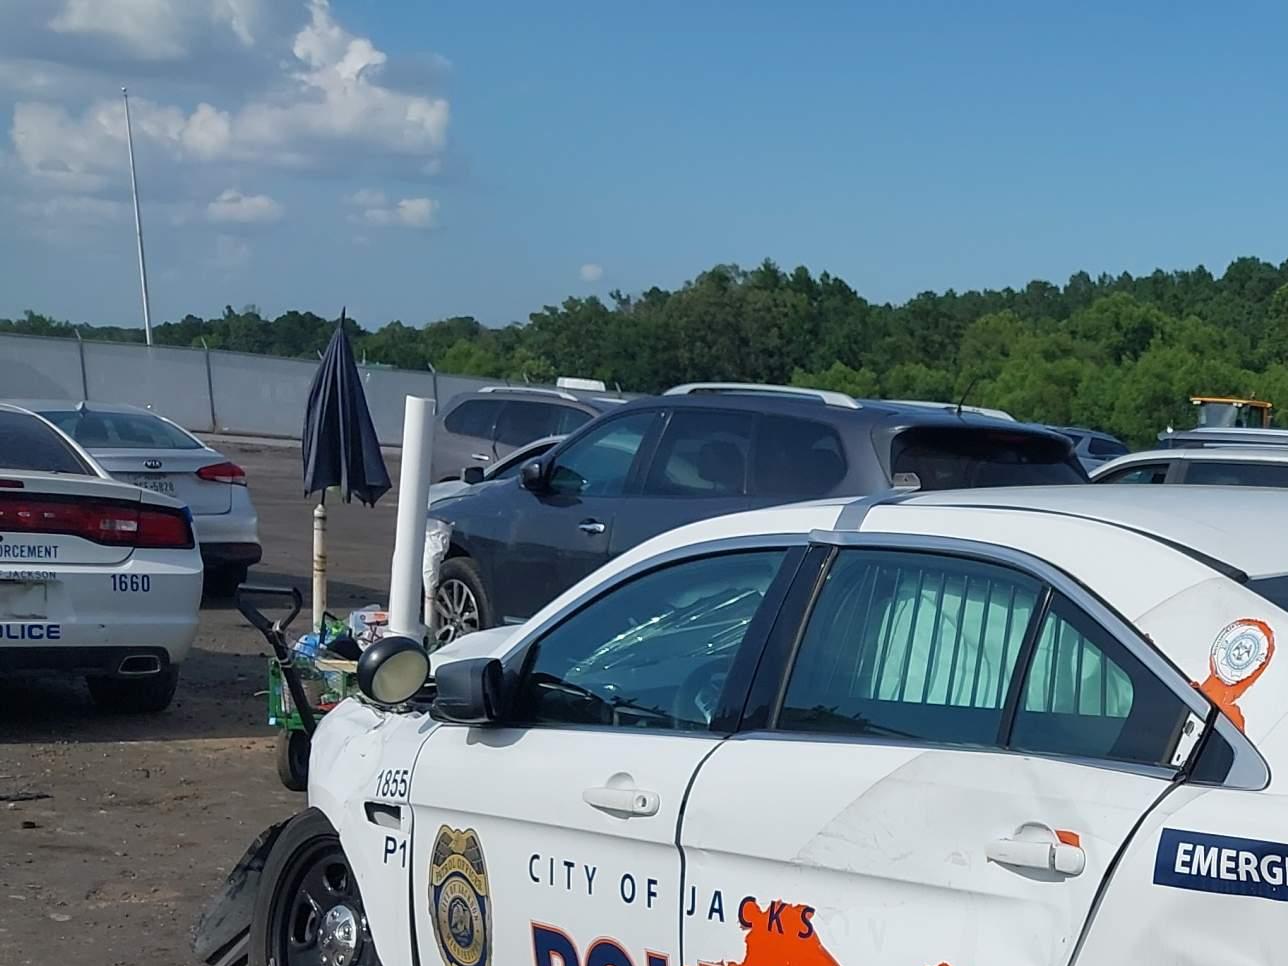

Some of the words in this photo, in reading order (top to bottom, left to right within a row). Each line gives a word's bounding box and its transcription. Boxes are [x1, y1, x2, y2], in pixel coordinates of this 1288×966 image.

[6, 570, 56, 580] JACKSON
[110, 573, 151, 593] 1660
[0, 624, 61, 640] LICE
[376, 769, 409, 798] 1855
[384, 835, 407, 869] P1
[528, 853, 597, 896] CITY
[620, 873, 658, 909] OF
[686, 885, 816, 939] JACKS
